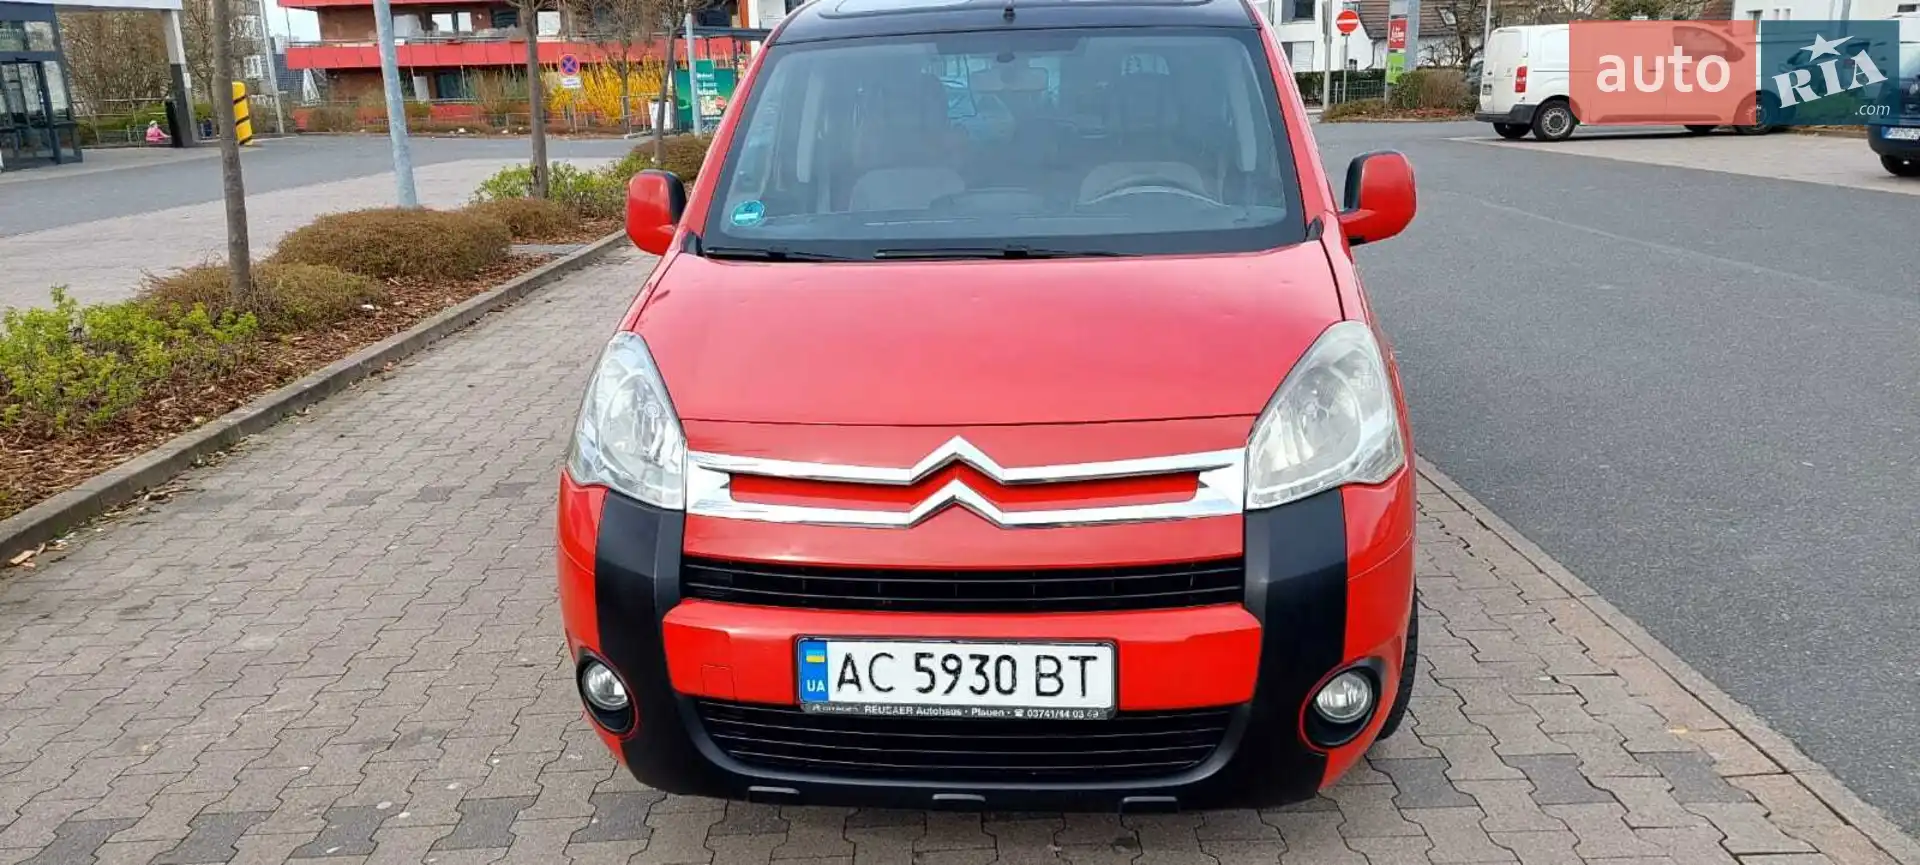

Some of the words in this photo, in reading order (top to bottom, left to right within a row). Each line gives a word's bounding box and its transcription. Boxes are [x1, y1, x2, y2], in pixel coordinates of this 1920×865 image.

[836, 652, 895, 693] AC
[914, 652, 1017, 696] 5930
[1035, 654, 1098, 698] BT
[806, 679, 825, 692] UA
[916, 706, 962, 717] Autohaus
[971, 707, 1005, 718] Plauen
